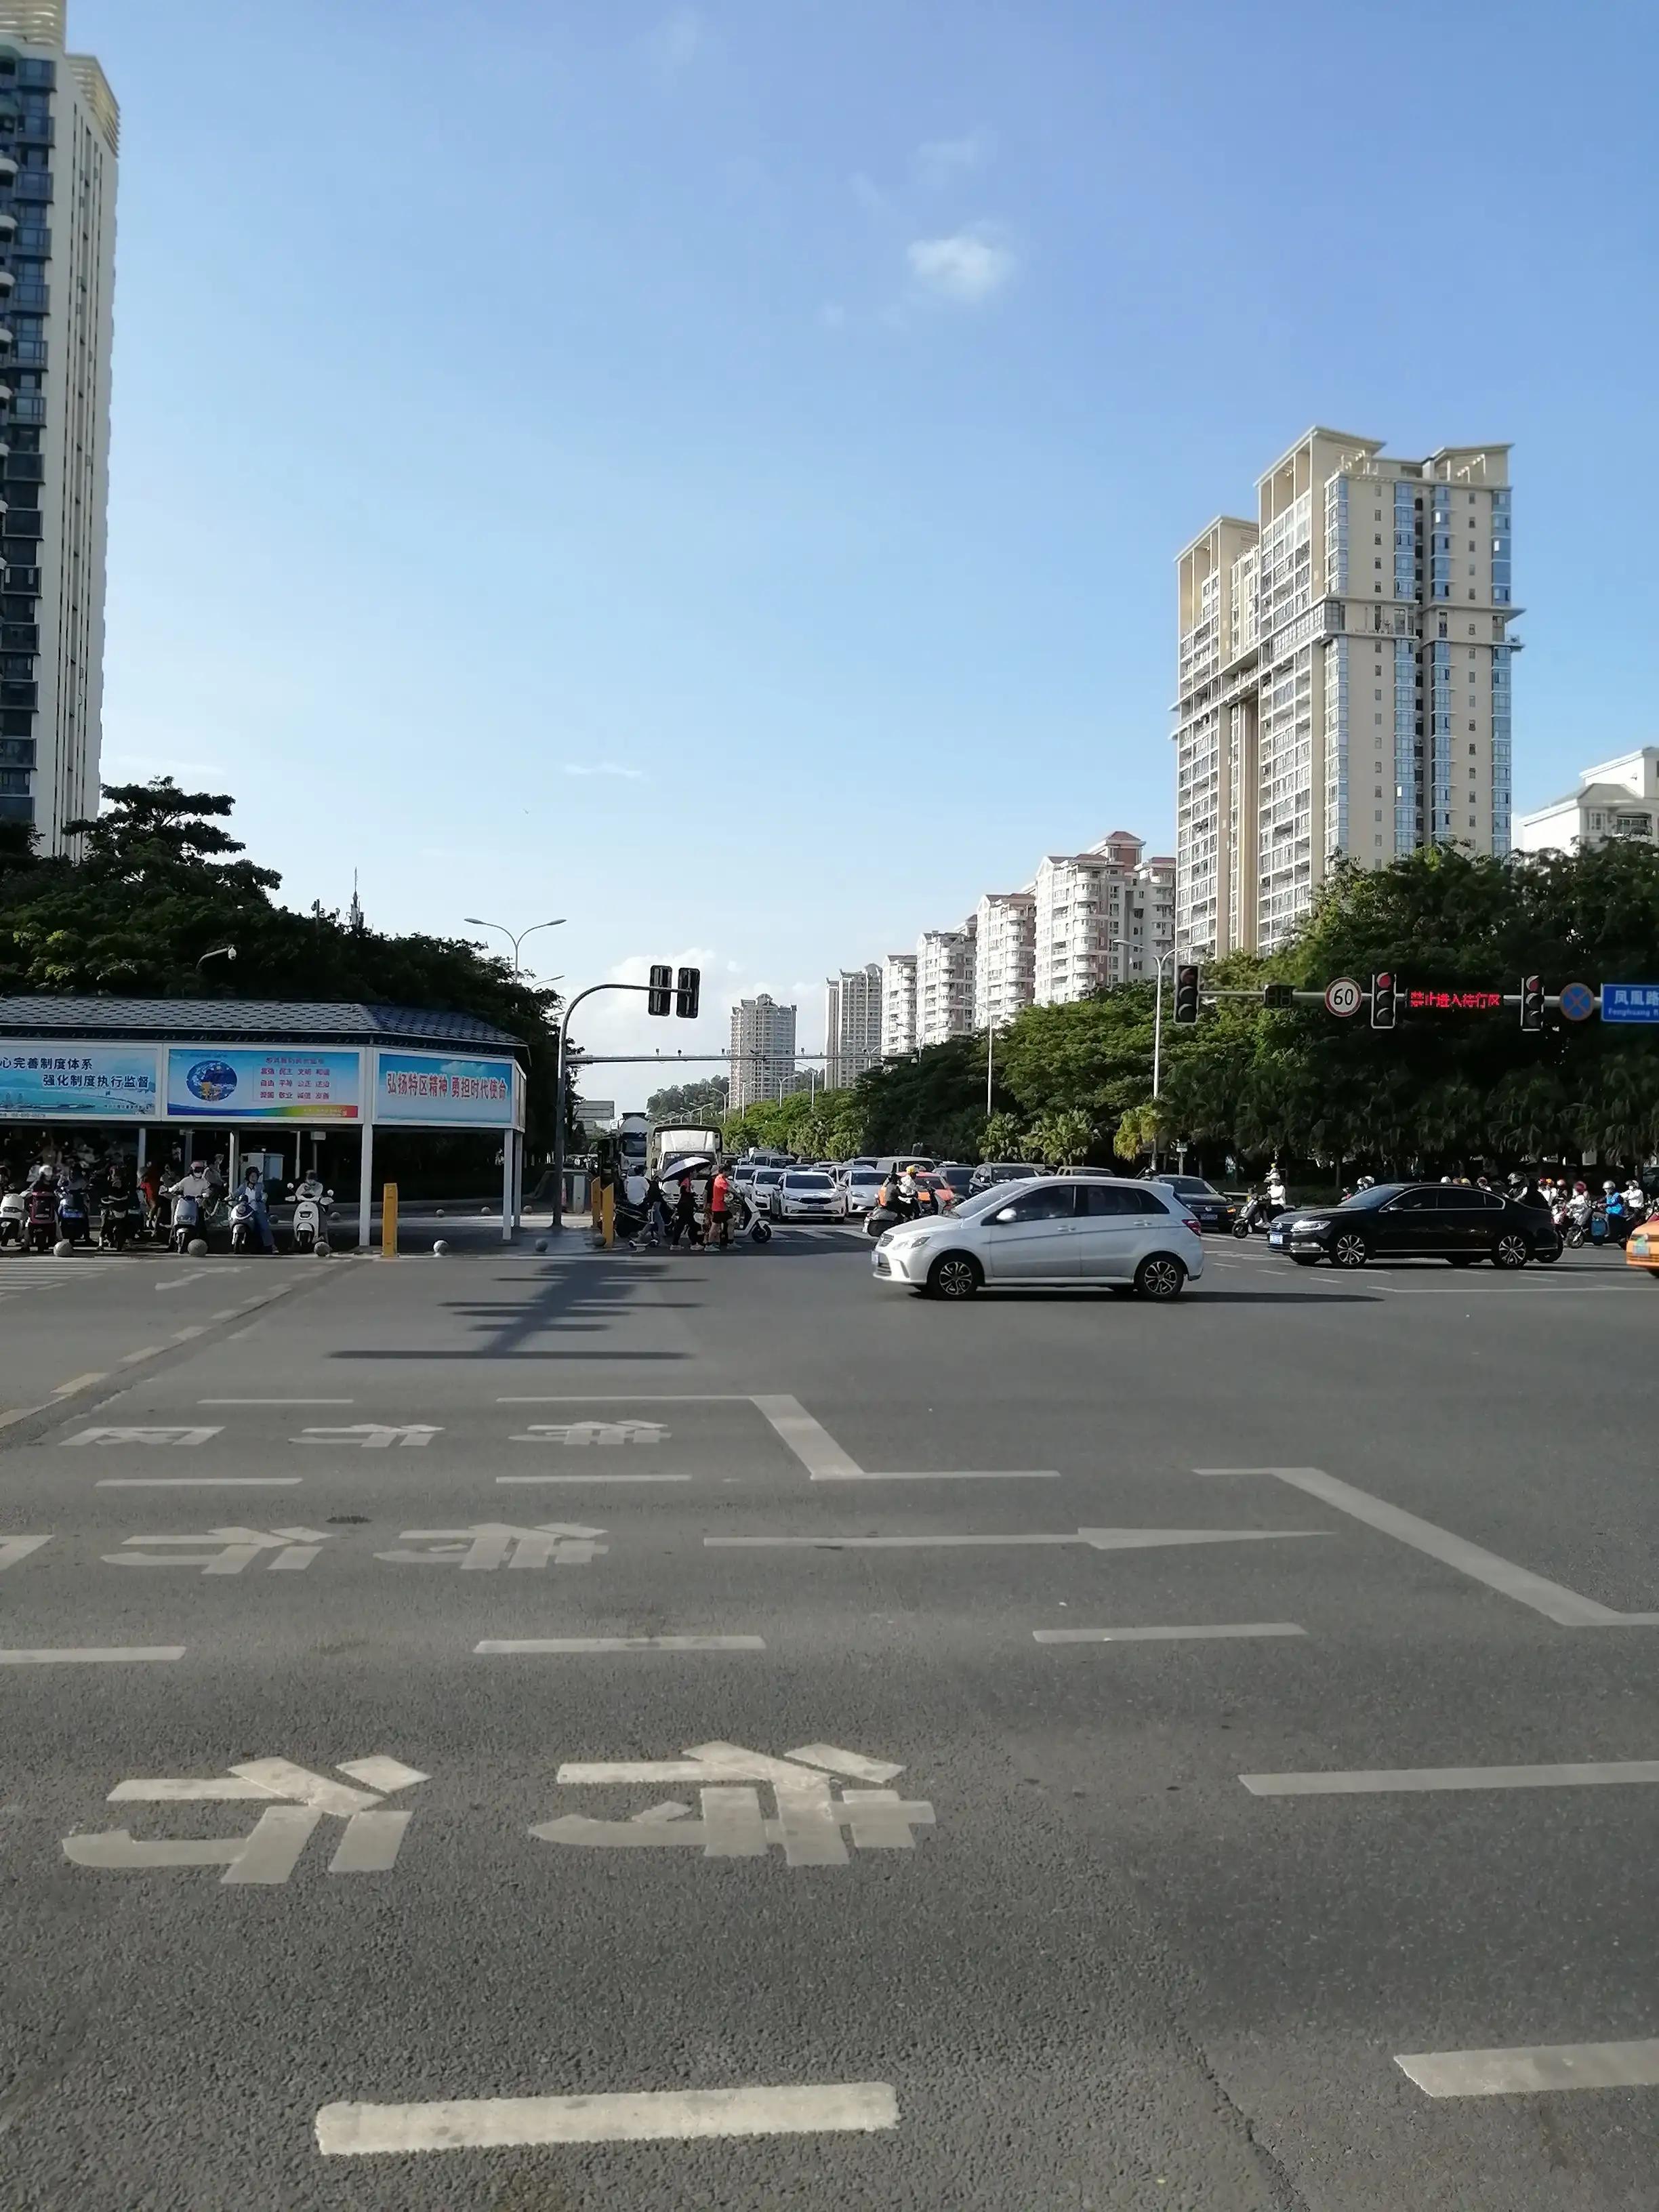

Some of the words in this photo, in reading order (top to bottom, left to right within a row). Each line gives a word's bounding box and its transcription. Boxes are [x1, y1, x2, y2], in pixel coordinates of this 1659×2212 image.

[1333, 988, 1354, 1006] 60
[1410, 990, 1500, 1008] 禁止进入待行区
[0, 1057, 93, 1070] 心完善制度体系
[43, 1074, 149, 1088] 强化制度执行监督
[387, 1073, 448, 1097] 弘扬特区精神
[451, 1077, 507, 1101] 勇担时代使命
